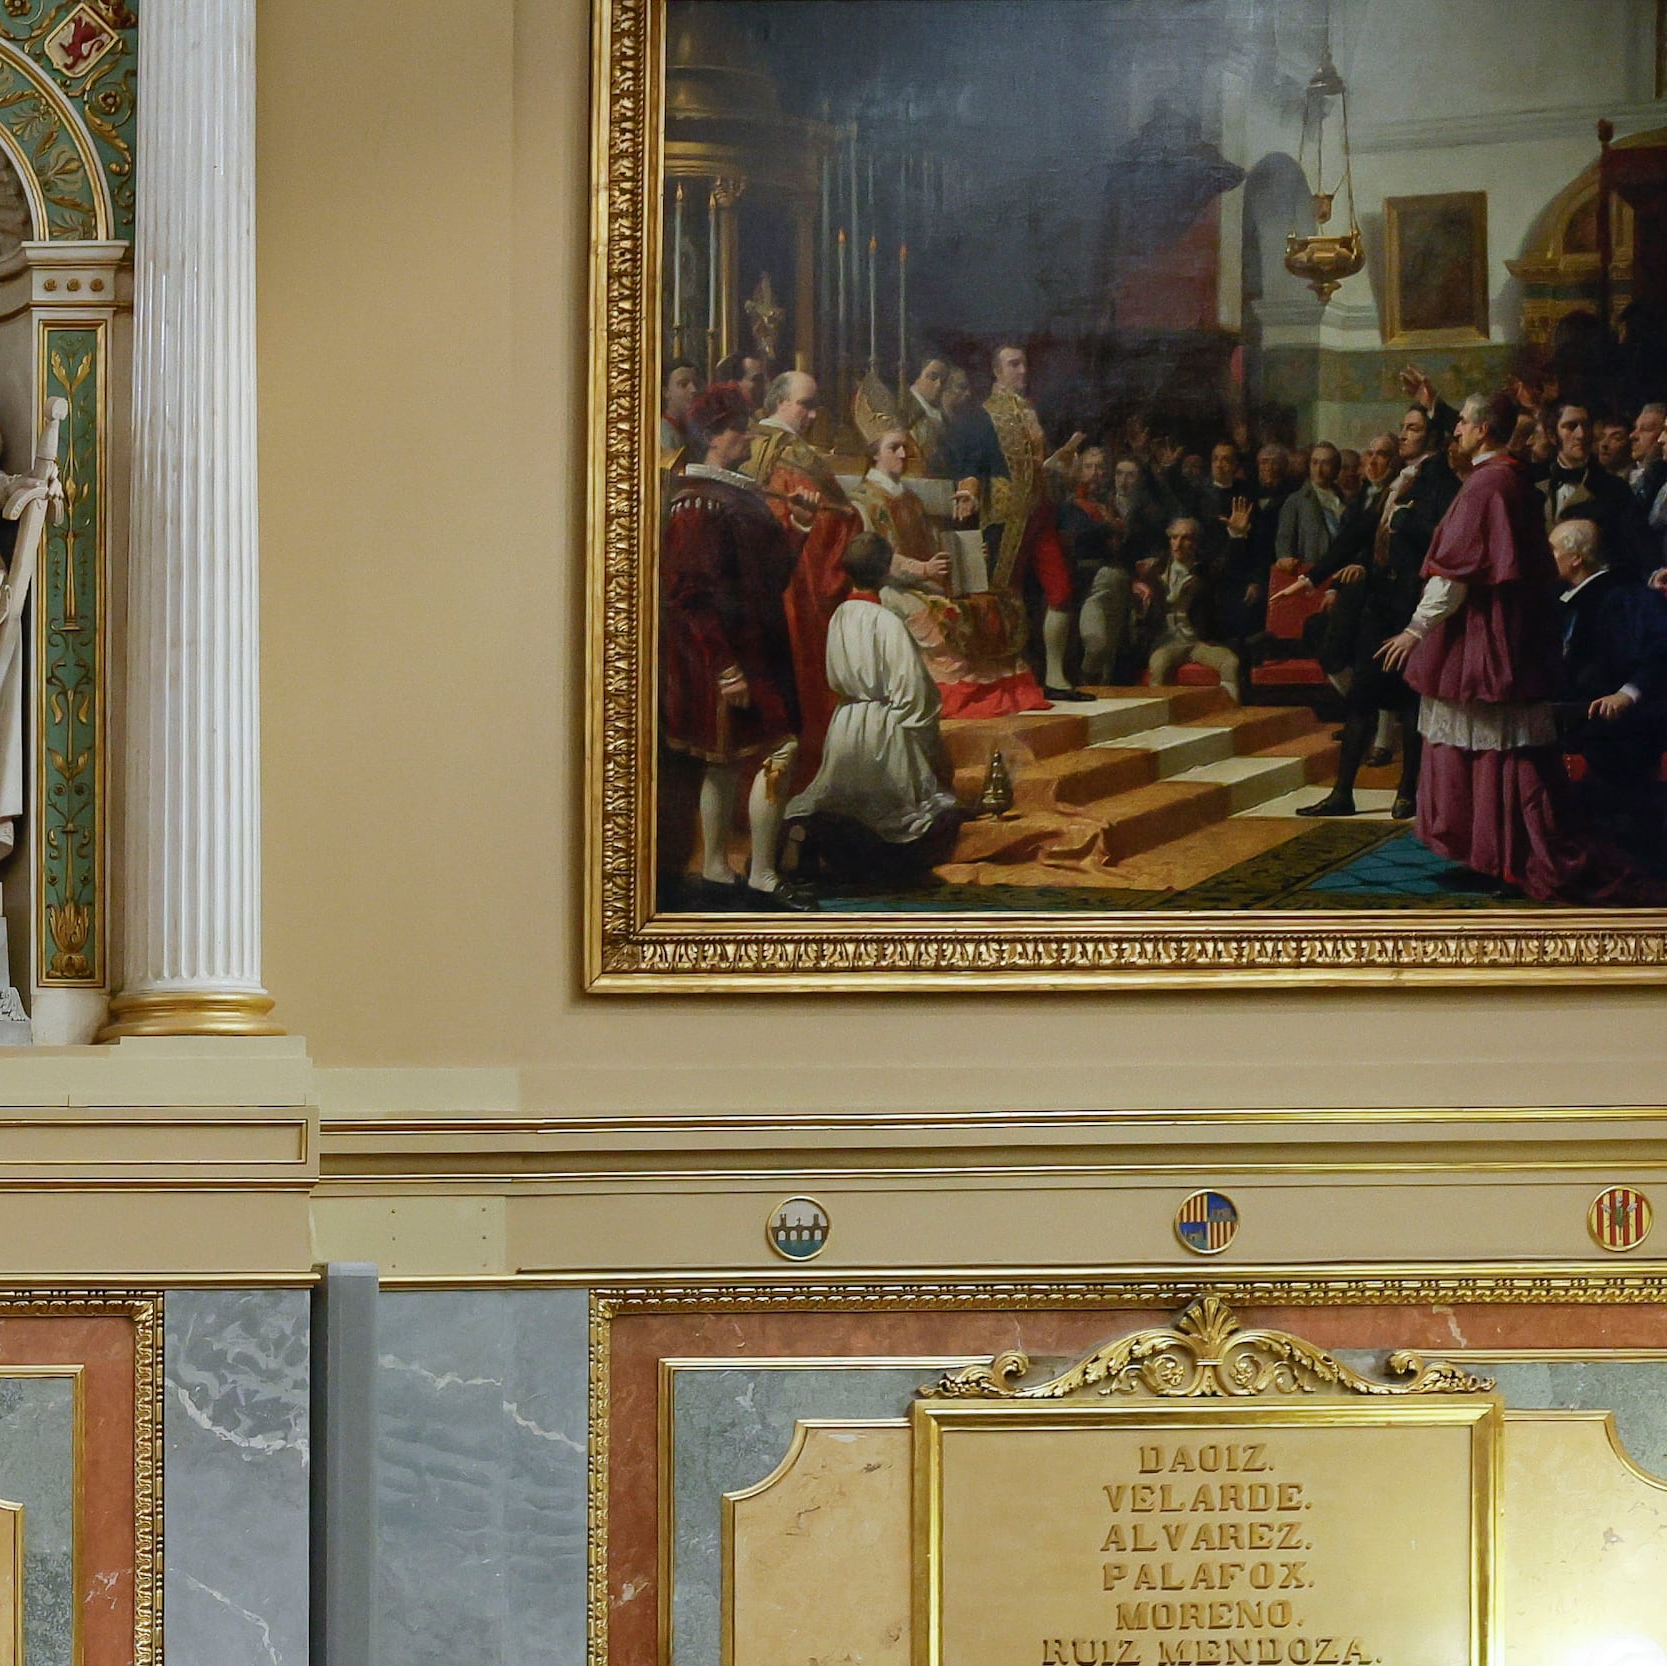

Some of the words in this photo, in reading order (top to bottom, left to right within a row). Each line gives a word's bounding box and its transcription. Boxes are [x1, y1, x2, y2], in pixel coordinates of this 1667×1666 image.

[1139, 1443, 1275, 1473] DAOIZ.
[1103, 1483, 1313, 1512] VELARDE.
[1100, 1522, 1314, 1552] ALVAREZ.
[1102, 1561, 1315, 1591] PALAFOX.
[1116, 1600, 1305, 1630] MORENO.
[1042, 1638, 1141, 1666] RUIZ
[1157, 1637, 1383, 1666] MENDOZA.
